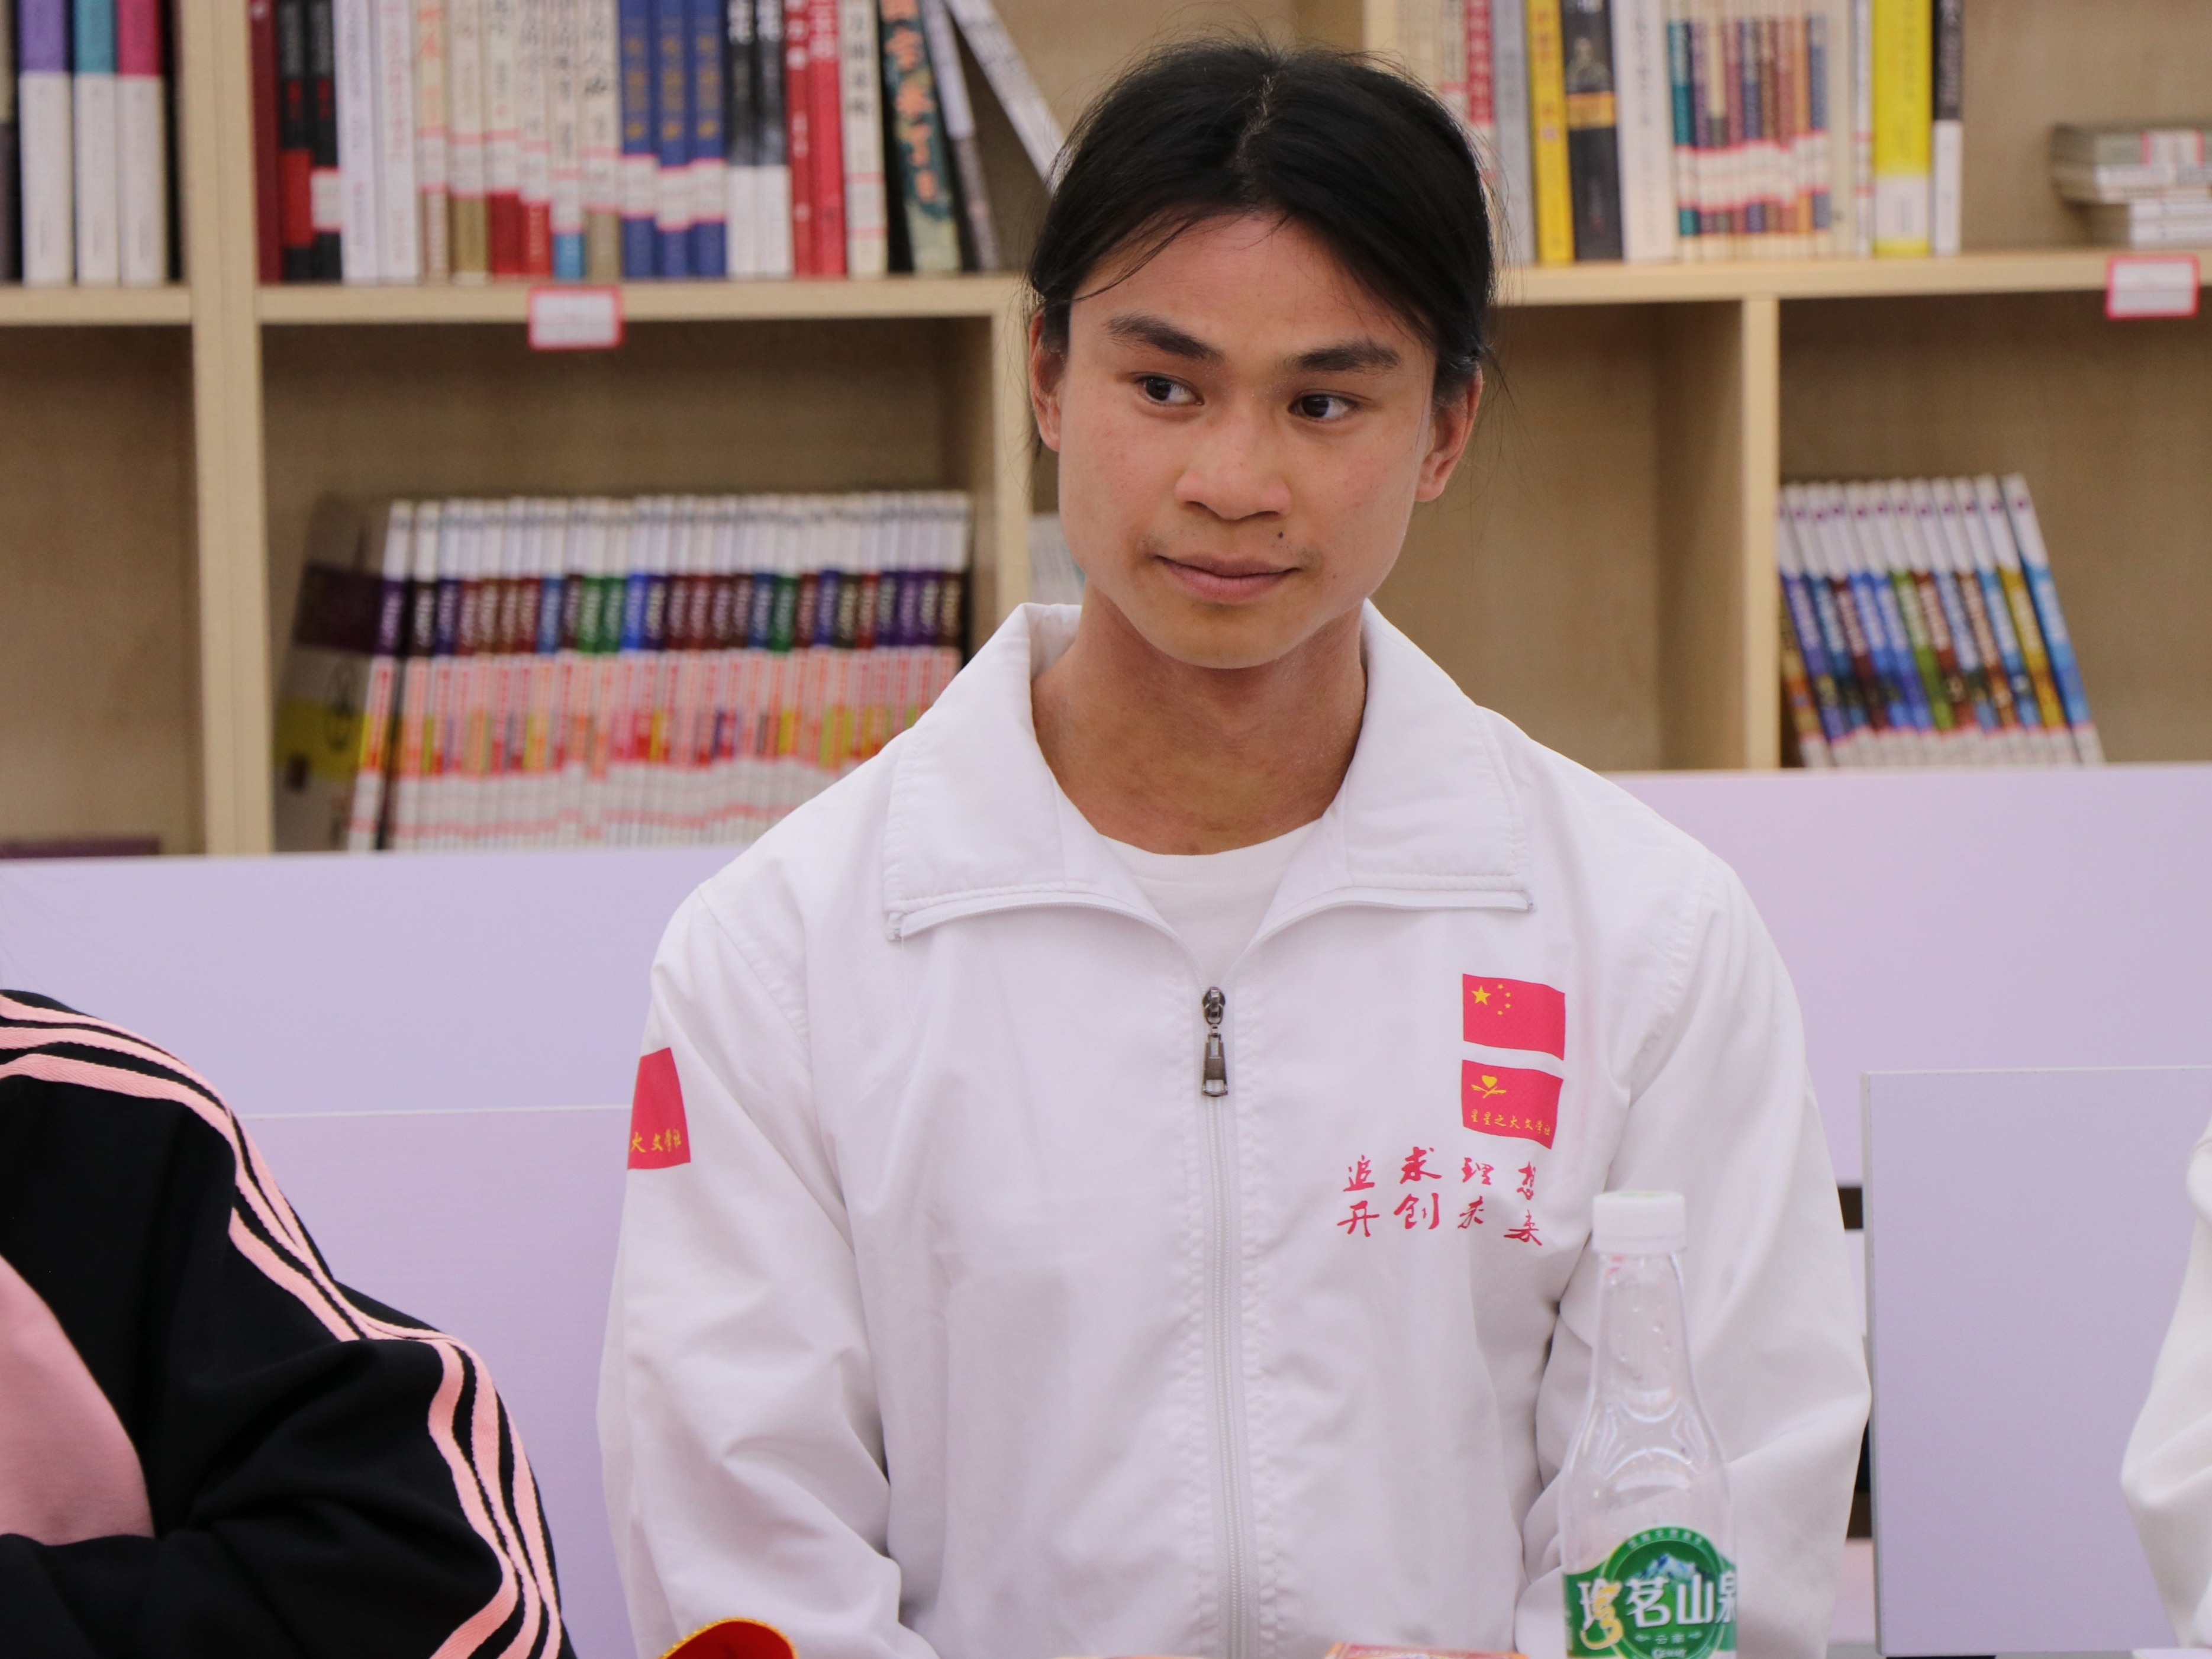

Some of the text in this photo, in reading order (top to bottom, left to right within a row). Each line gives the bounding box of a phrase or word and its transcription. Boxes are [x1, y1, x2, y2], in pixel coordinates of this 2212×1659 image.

[1471, 1109, 1550, 1136] 星星之火文学社
[1342, 1146, 1537, 1200] 追求理想
[1337, 1193, 1543, 1246] 开创未来
